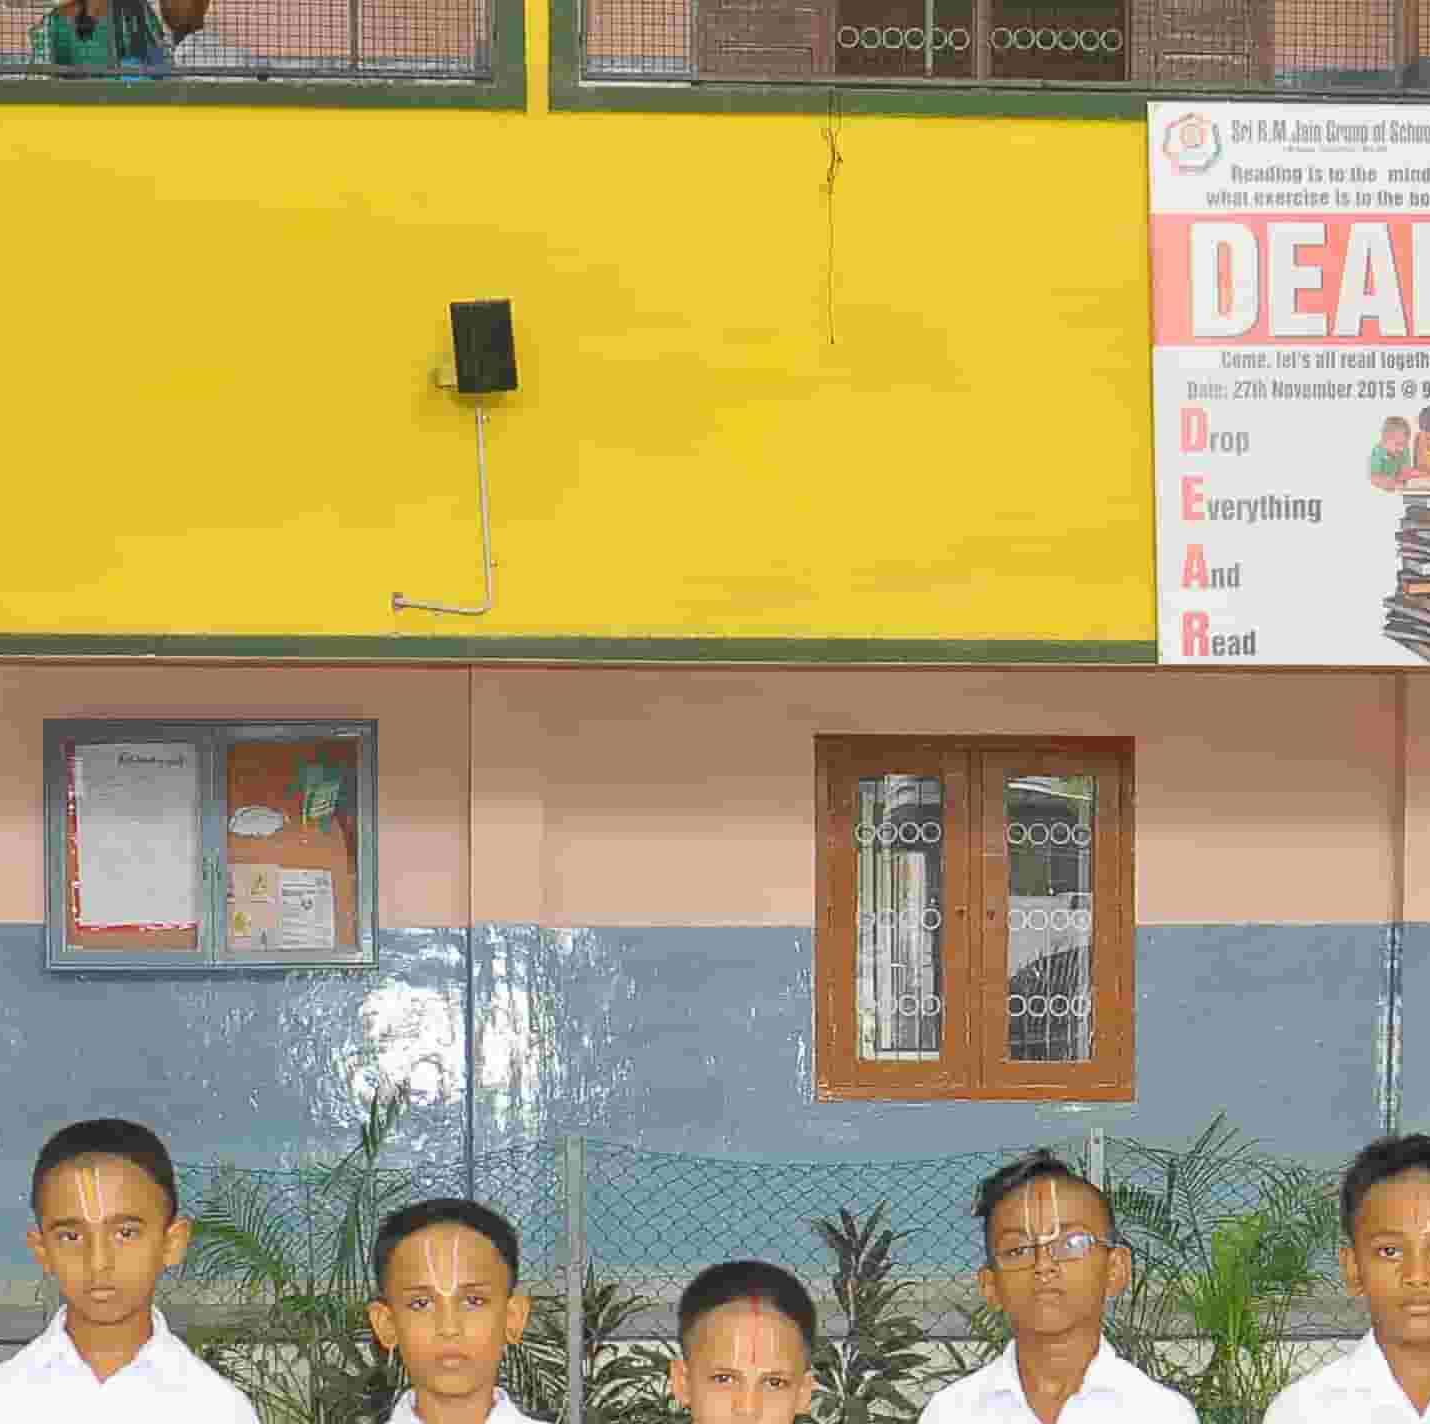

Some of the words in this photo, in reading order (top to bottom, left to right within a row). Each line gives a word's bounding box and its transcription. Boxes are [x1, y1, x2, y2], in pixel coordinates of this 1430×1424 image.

[1231, 118, 1253, 144] Sri
[1326, 120, 1369, 146] Group
[1373, 120, 1386, 144] of
[1231, 164, 1303, 186] Reading
[1308, 166, 1324, 183] is
[1329, 167, 1345, 183] to
[1349, 166, 1378, 183] the
[1206, 190, 1249, 208] what
[1253, 191, 1330, 208] exercise
[1335, 190, 1350, 207] is
[1355, 191, 1372, 207] to
[1377, 190, 1404, 208] the
[1276, 351, 1311, 369] let's
[1315, 351, 1336, 369] all
[1340, 351, 1376, 370] read
[1186, 381, 1228, 400] Date:
[1232, 380, 1268, 400] 27th
[1272, 380, 1353, 400] November
[1357, 380, 1396, 400] 2015
[1401, 381, 1418, 400] @
[1179, 407, 1250, 454] Drop
[1179, 474, 1323, 524] Everything
[1179, 544, 1242, 590] And
[1180, 610, 1258, 658] Read
